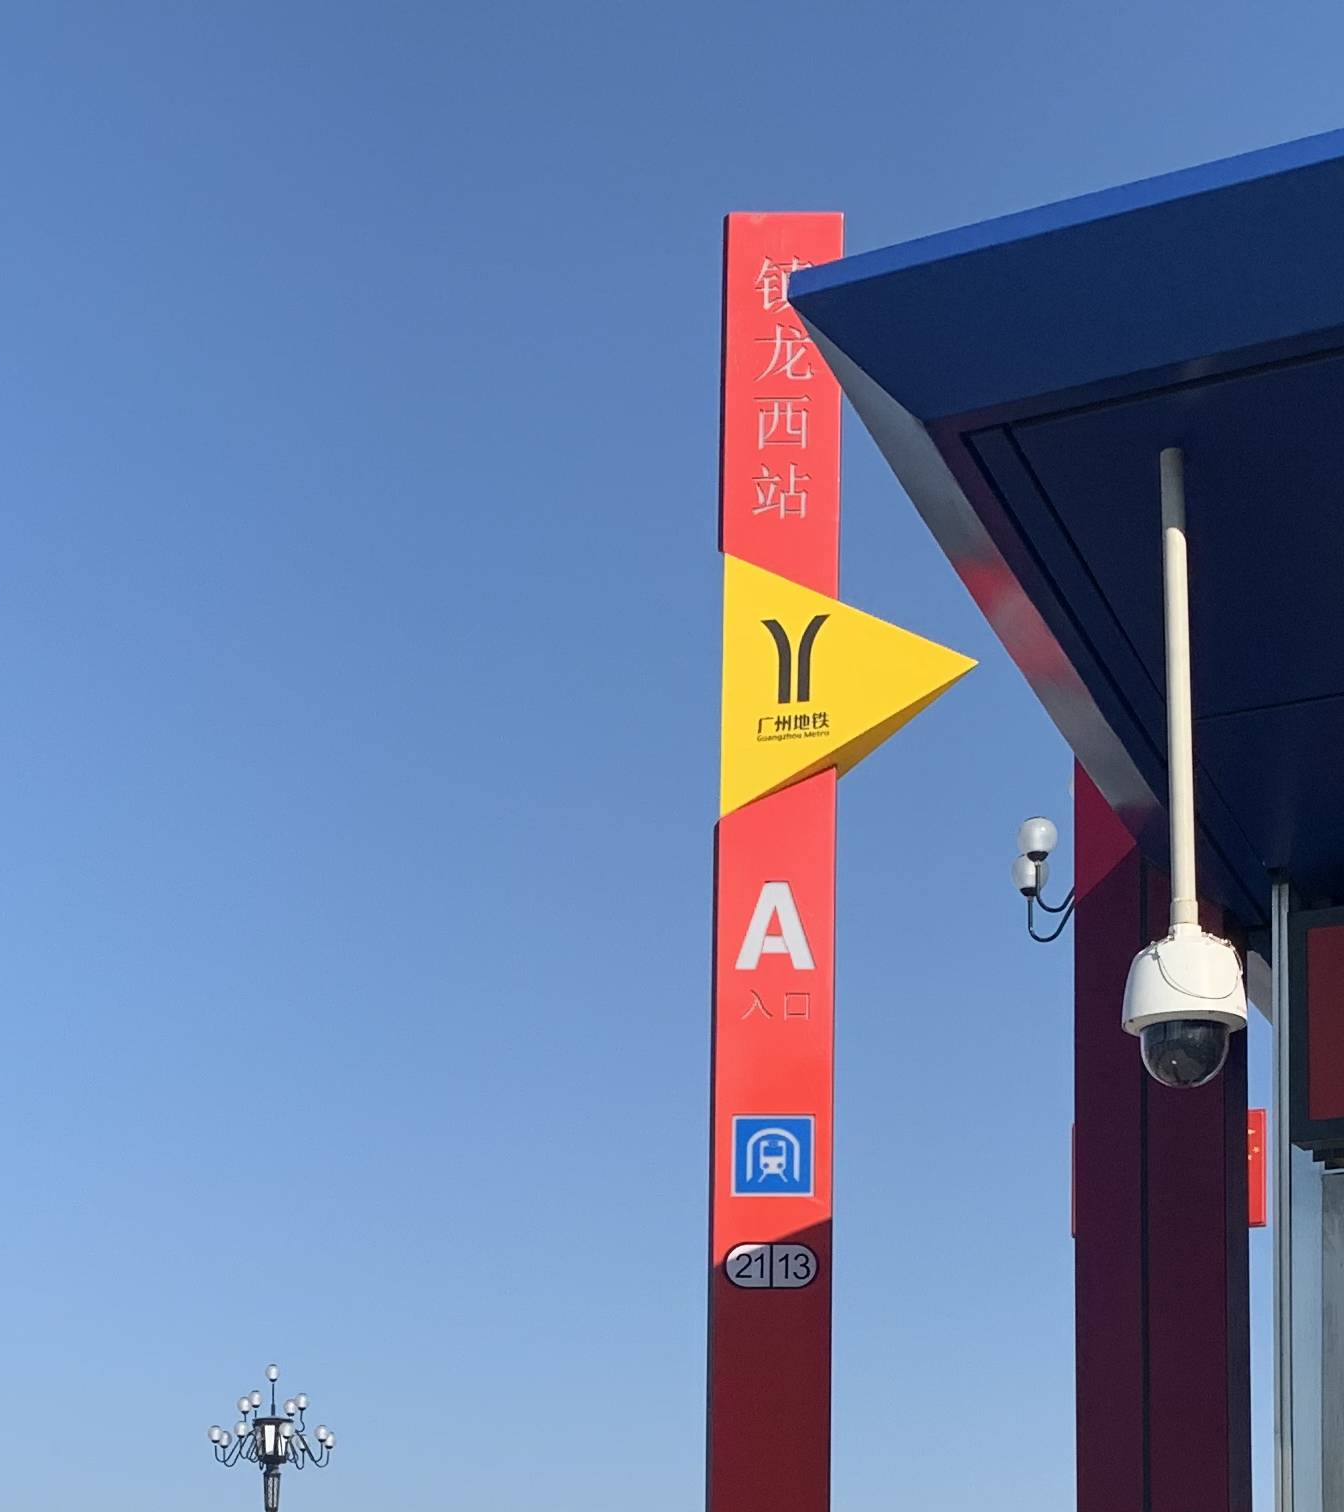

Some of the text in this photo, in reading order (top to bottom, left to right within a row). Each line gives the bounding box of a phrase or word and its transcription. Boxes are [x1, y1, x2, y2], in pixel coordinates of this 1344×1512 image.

[757, 711, 830, 734] 广州地铁
[734, 880, 817, 971] A
[741, 988, 812, 1022] 入口
